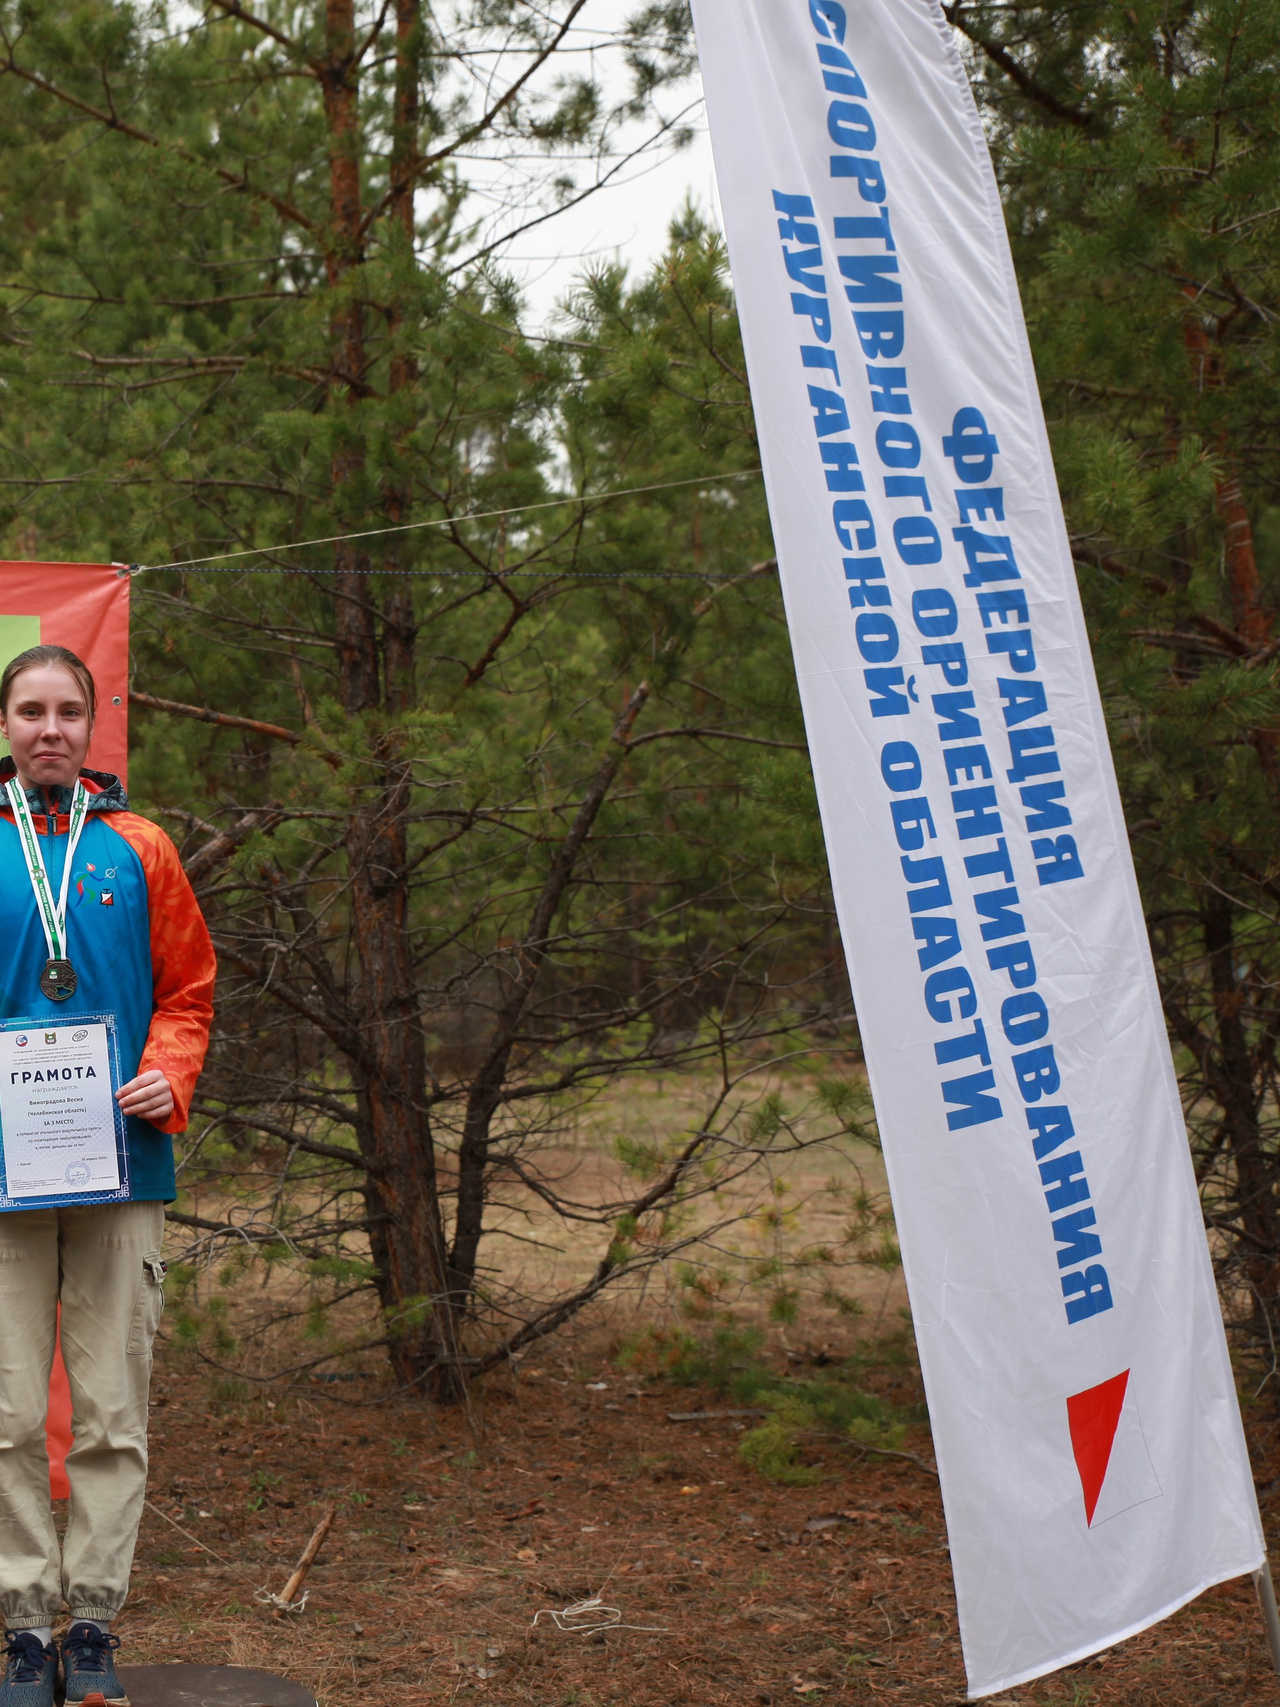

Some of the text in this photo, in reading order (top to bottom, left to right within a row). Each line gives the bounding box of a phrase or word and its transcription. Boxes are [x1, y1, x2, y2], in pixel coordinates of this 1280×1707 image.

[773, 190, 1003, 1131] КУРГАНСКОЙ ОБЛАСТИ
[808, 0, 1113, 1324] СПОРТИВНОГО ОРИЕНТИРОВАНИЯ
[943, 407, 1085, 885] ФЕДЕРАЦИЯ
[10, 1065, 97, 1085] ГРАМОТА
